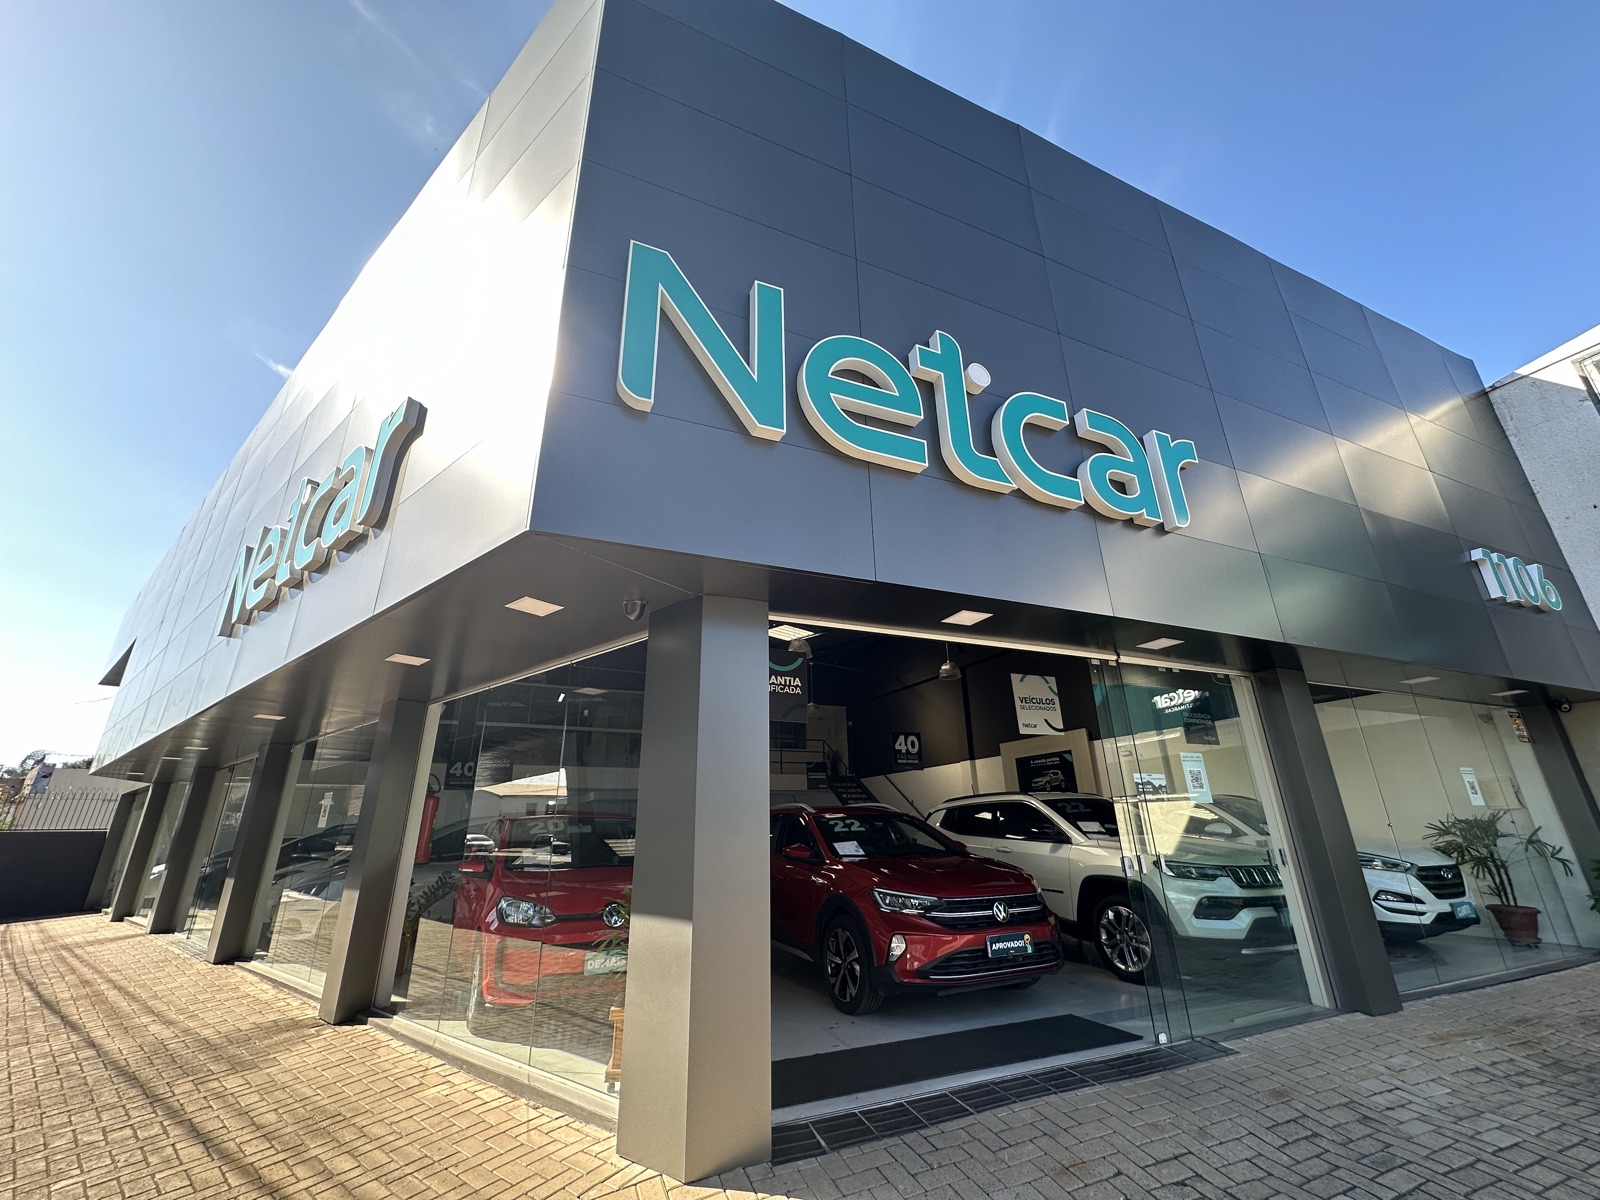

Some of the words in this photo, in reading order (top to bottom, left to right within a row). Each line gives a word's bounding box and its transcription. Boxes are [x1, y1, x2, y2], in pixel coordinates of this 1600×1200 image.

[616, 240, 1198, 531] Netcar
[216, 397, 427, 637] Netcar
[1470, 548, 1562, 611] 1106
[769, 675, 802, 686] ANTIA
[1018, 695, 1056, 706] VEÍCULOS
[1019, 704, 1057, 712] SELECIONADOS
[894, 735, 919, 754] 40
[449, 761, 475, 777] 40
[828, 819, 866, 832] 22
[992, 940, 1025, 951] APROVADO!
